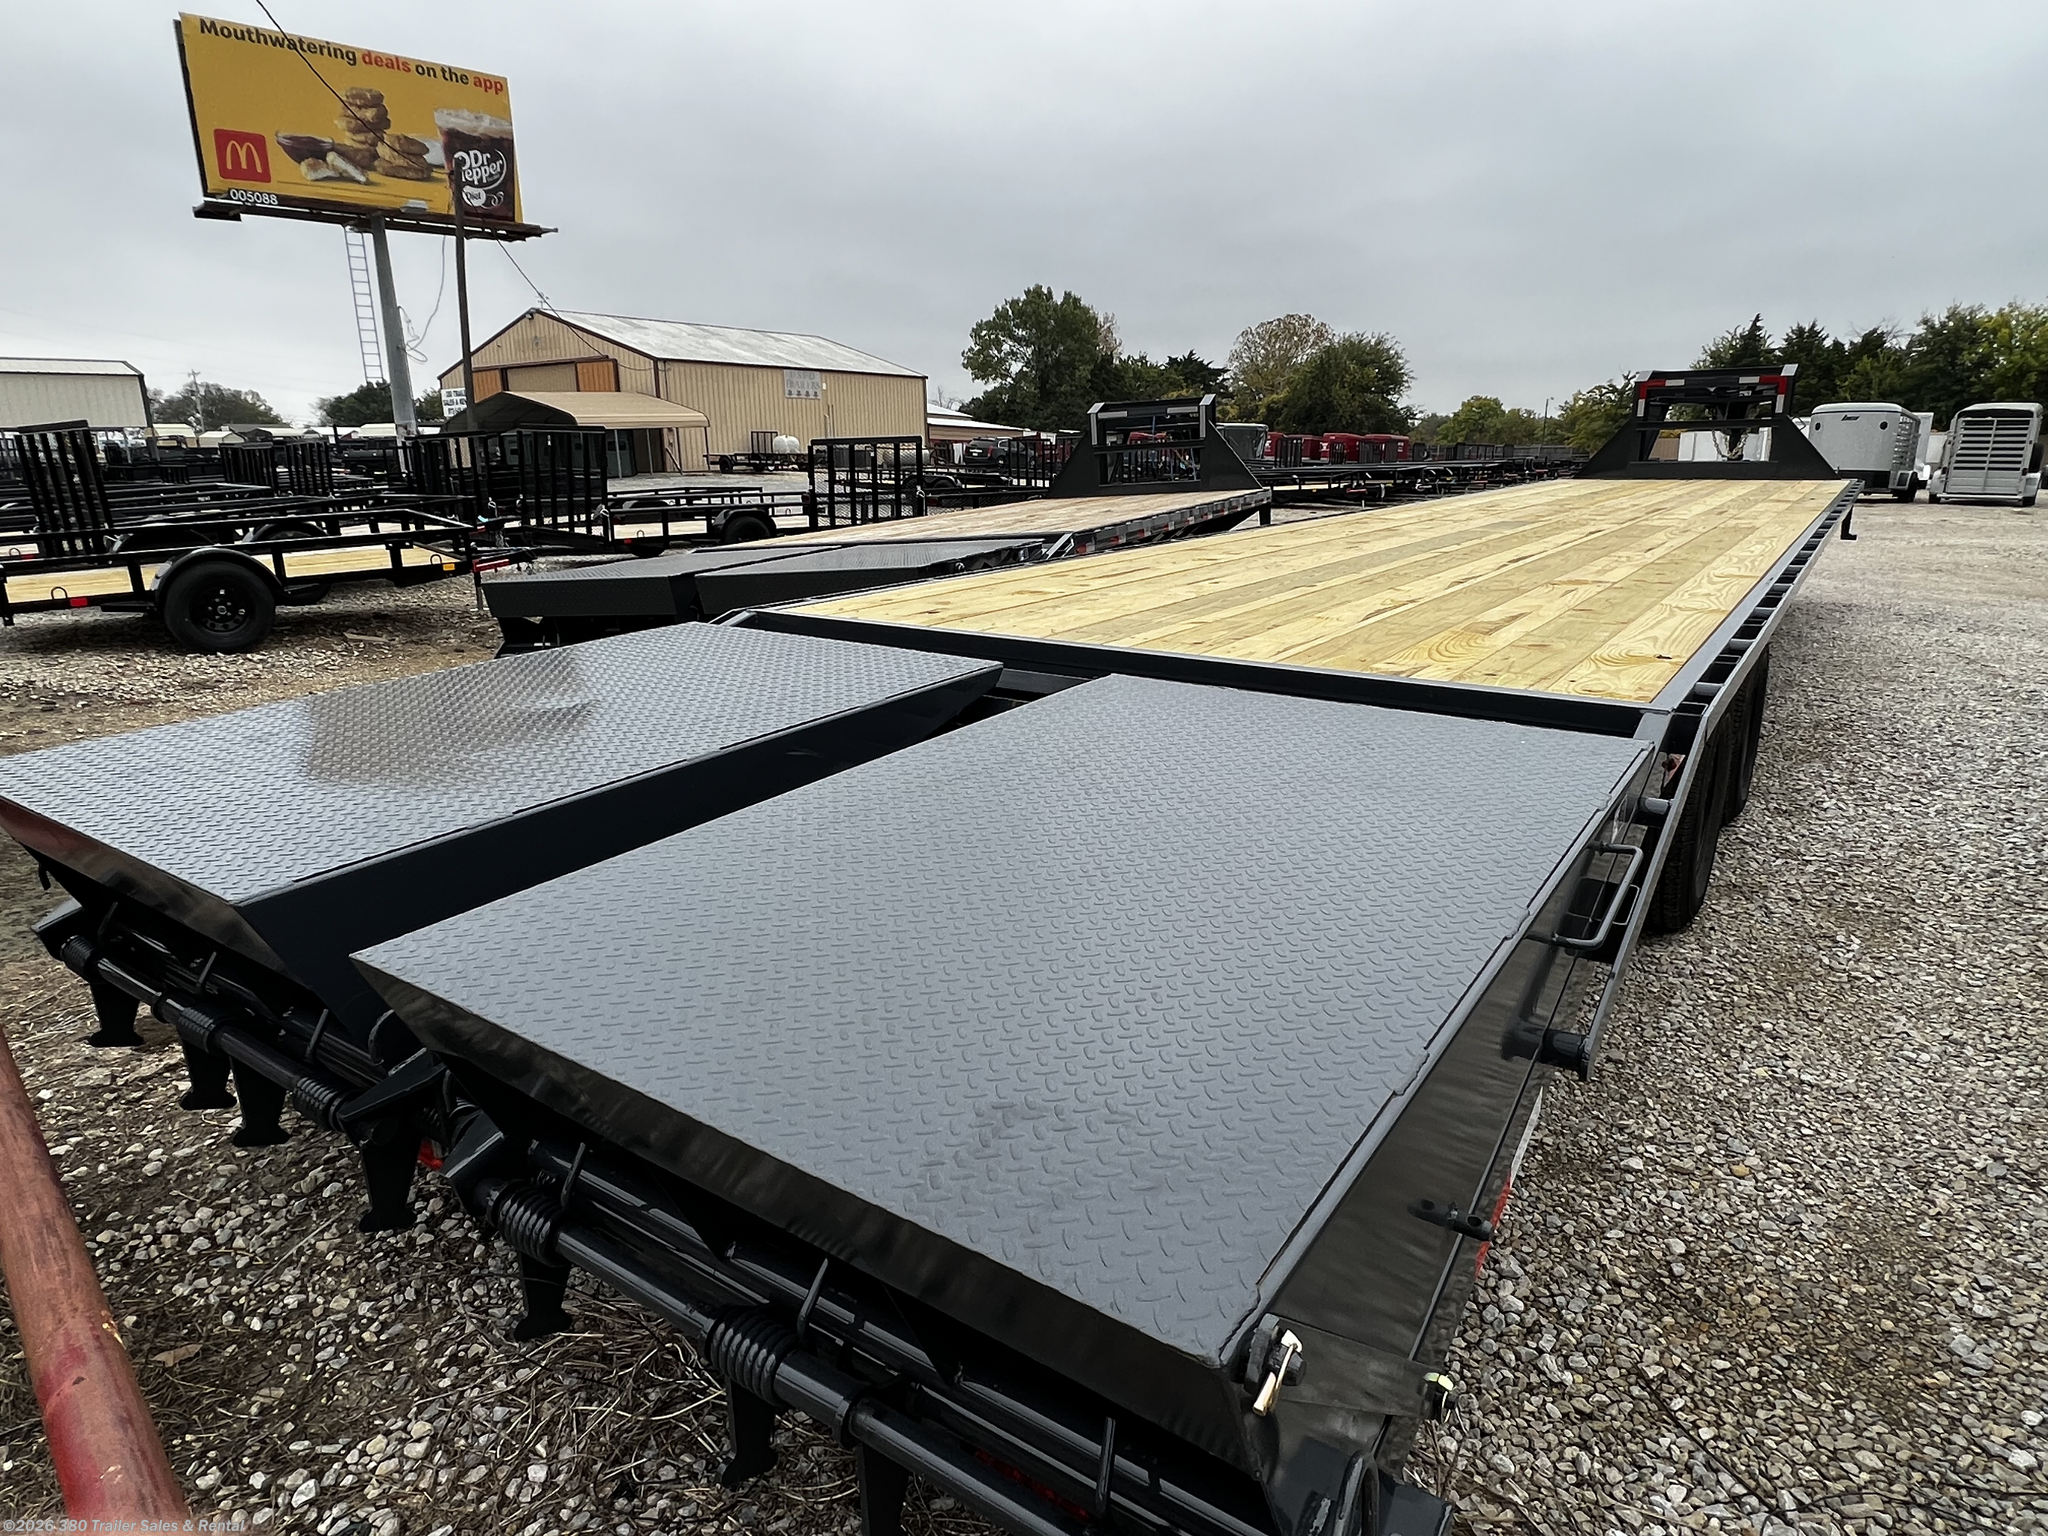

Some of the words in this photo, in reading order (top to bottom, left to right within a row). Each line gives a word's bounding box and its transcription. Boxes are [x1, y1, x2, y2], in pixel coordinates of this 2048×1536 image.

[199, 18, 357, 66] Mouthwatering
[362, 50, 411, 73] deals
[415, 63, 437, 79] on
[441, 66, 469, 85] the
[473, 76, 504, 95] app
[469, 150, 491, 168] Dr
[229, 188, 278, 205] 005088
